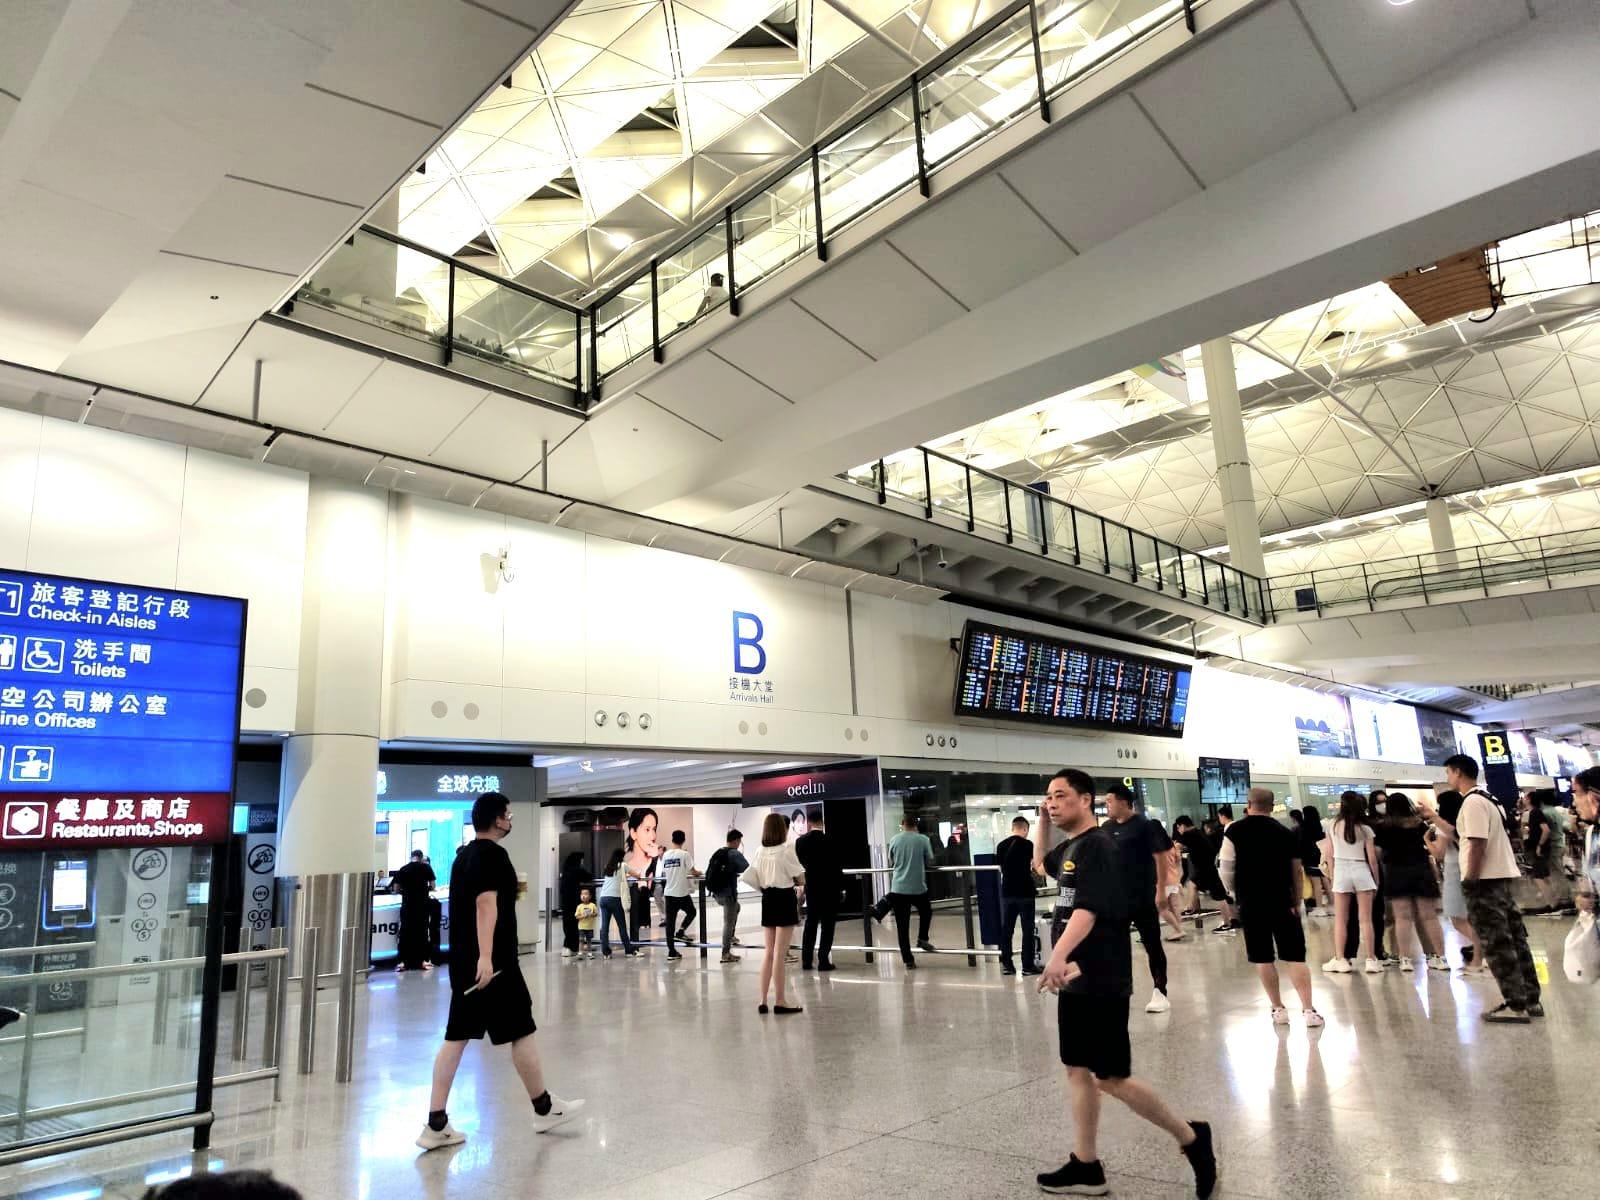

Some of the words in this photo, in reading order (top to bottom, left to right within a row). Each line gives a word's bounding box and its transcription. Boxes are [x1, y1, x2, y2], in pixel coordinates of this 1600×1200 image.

[30, 581, 190, 619] 旅客登記行段
[28, 603, 102, 625] Check-in
[106, 608, 157, 630] Aisles
[73, 638, 152, 664] 洗手間
[733, 610, 766, 674] B
[70, 661, 127, 678] Toilets
[1, 687, 168, 716] 空公司辦公室
[730, 692, 758, 703] Arrivals
[760, 694, 774, 704] Hall
[34, 711, 97, 729] Offices
[1485, 736, 1505, 756] B
[54, 797, 191, 822] 餐廳及商店
